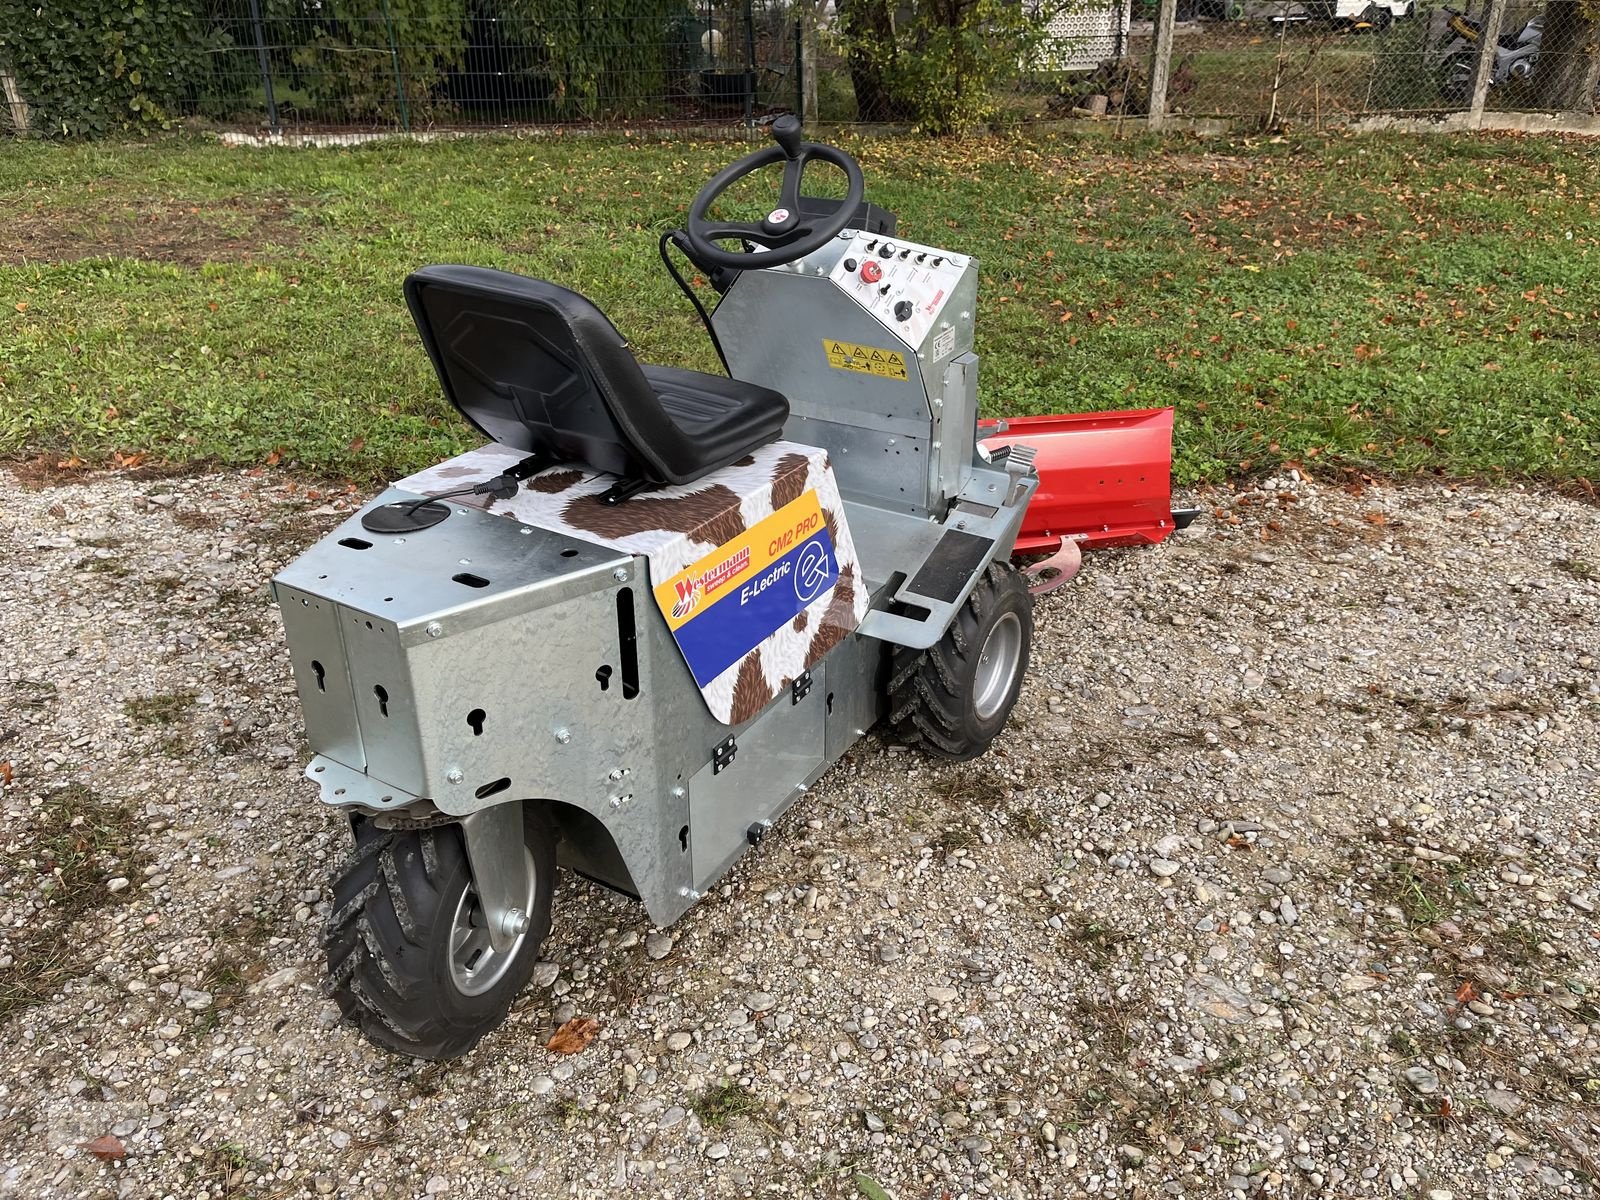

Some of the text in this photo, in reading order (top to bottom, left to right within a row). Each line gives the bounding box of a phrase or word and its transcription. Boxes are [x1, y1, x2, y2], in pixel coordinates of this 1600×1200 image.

[768, 512, 818, 557] CM2 PRO
[674, 546, 750, 603] Westermann
[706, 575, 726, 592] sweep
[740, 561, 791, 606] E-Lectric
